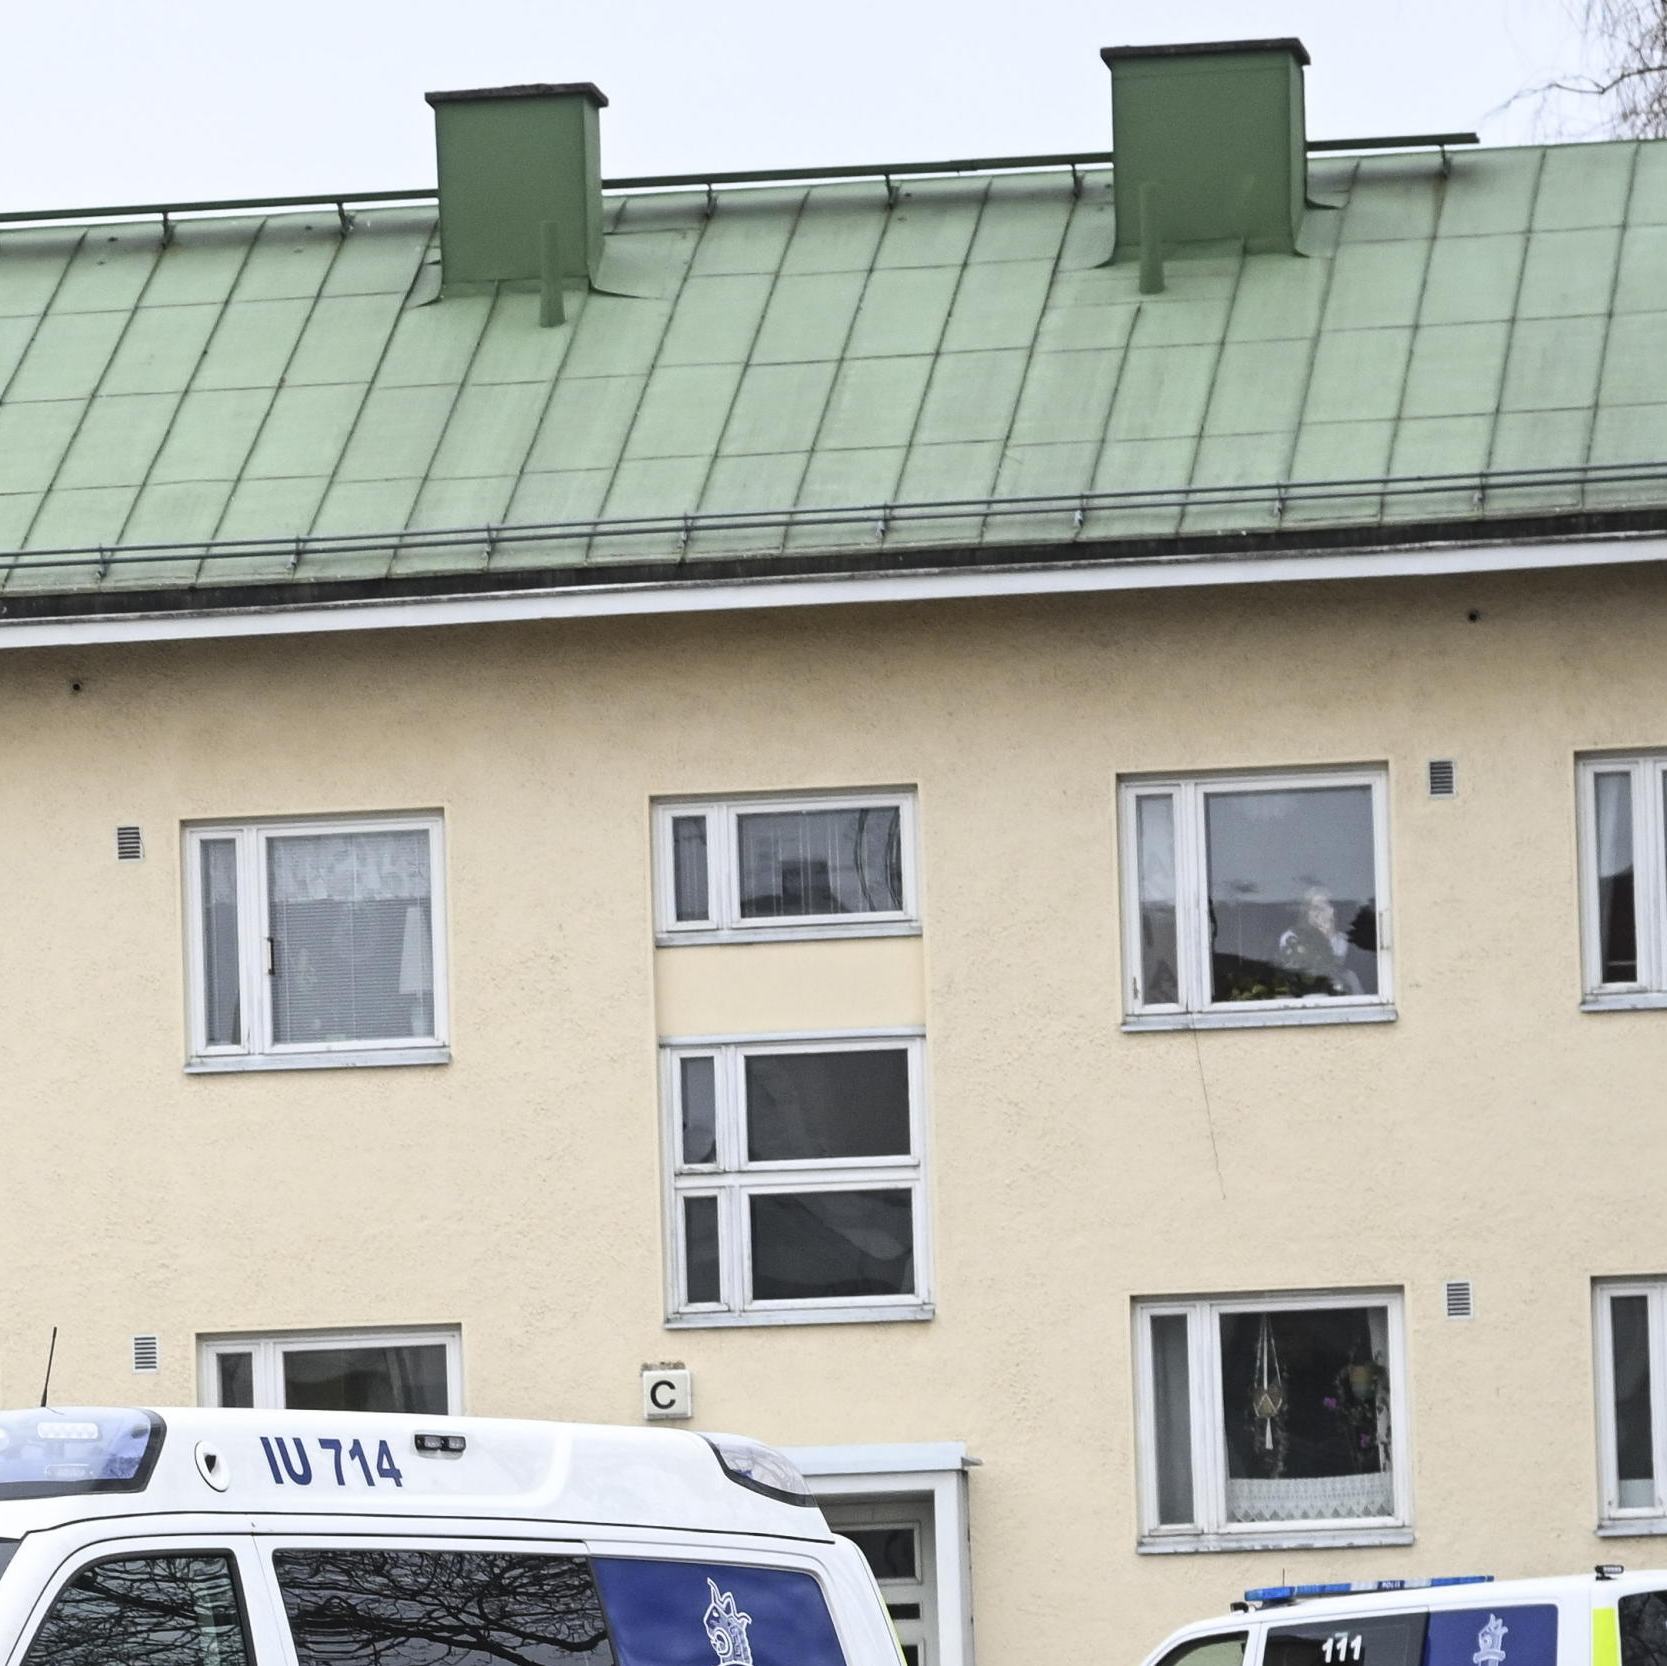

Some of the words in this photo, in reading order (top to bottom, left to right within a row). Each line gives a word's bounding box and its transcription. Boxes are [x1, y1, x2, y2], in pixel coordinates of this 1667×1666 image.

[650, 1379, 677, 1410] C
[260, 1436, 313, 1486] IU
[320, 1437, 404, 1487] 714
